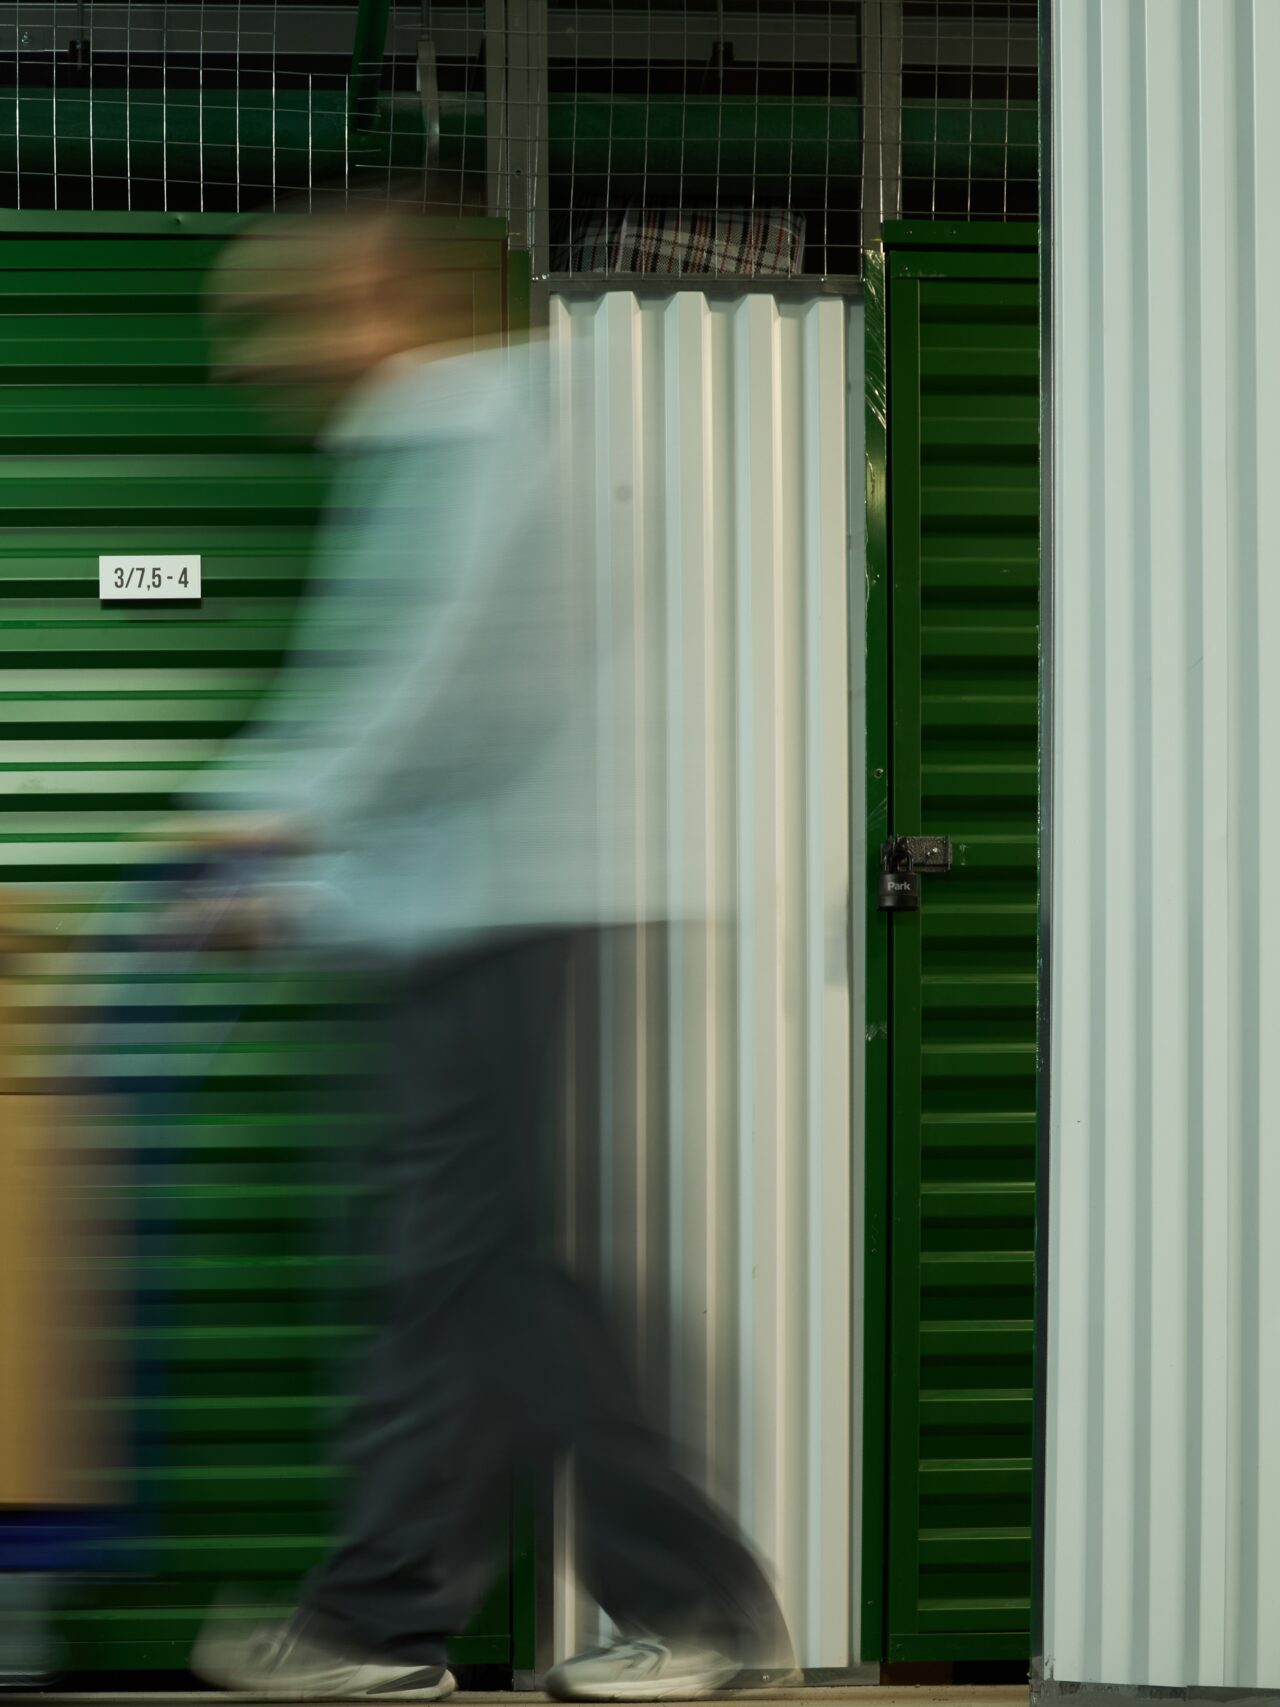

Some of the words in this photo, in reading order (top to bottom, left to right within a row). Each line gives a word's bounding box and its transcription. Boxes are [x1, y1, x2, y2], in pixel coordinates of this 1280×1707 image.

[114, 567, 162, 591] 3/7,5
[178, 567, 189, 588] 4
[887, 881, 911, 891] Park
